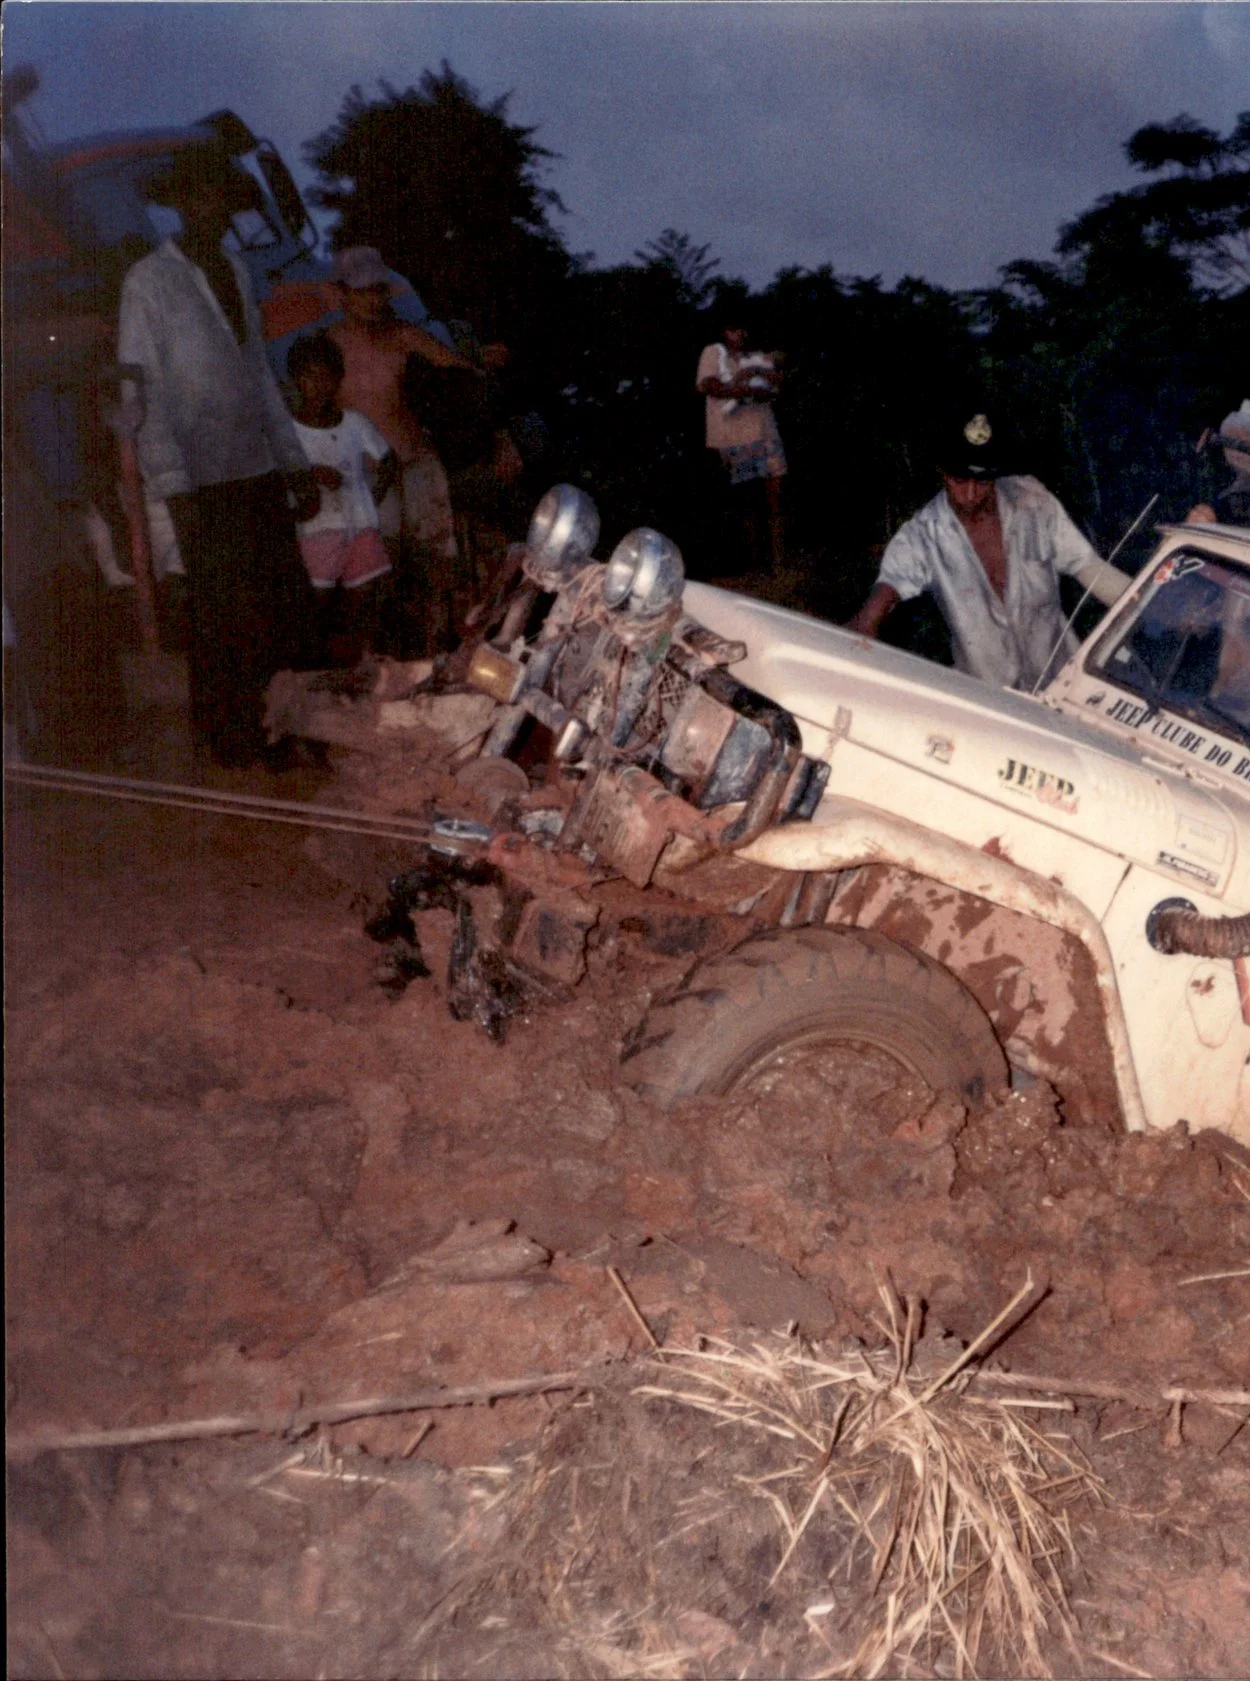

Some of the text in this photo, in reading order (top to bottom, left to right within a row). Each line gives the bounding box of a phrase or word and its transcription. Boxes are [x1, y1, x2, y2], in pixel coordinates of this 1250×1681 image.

[1105, 698, 1153, 729] JEEP
[1151, 718, 1206, 755] CLUBE
[1204, 743, 1233, 767] DO
